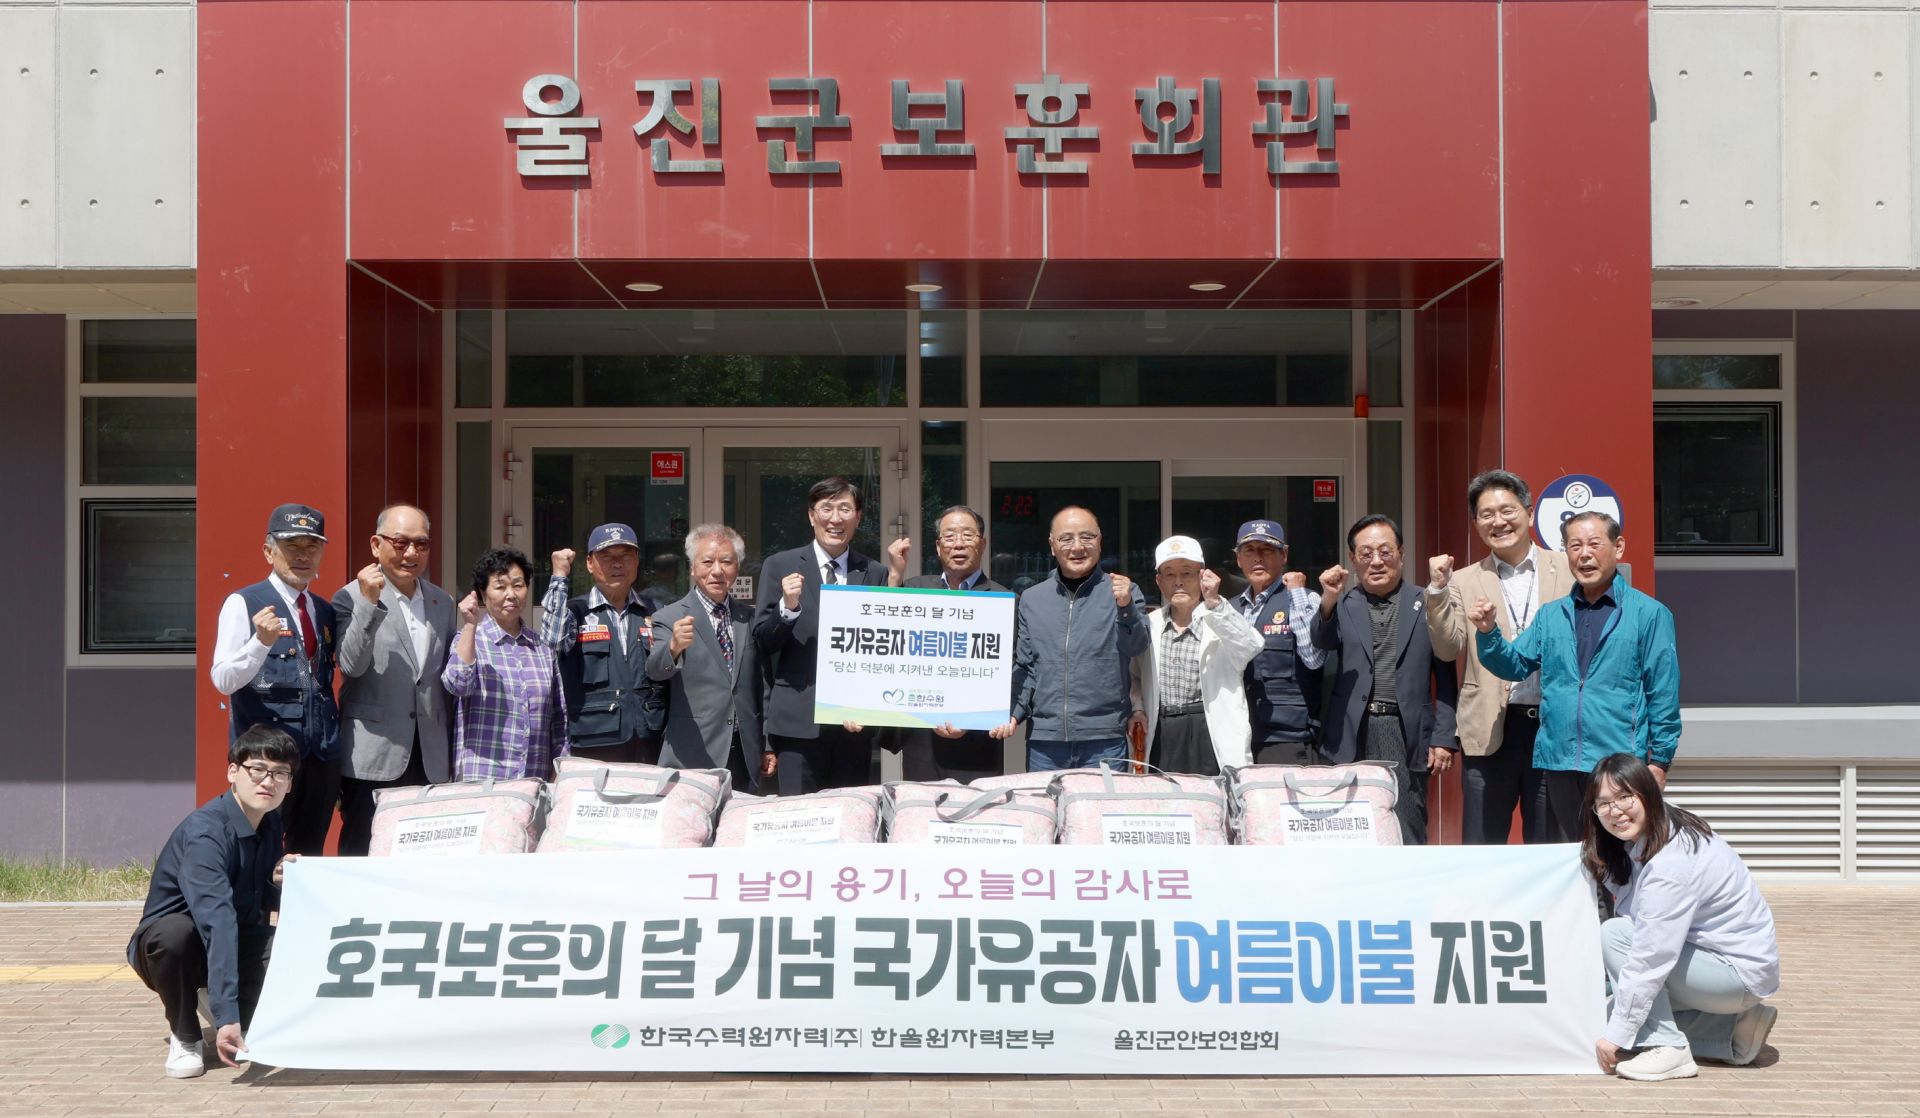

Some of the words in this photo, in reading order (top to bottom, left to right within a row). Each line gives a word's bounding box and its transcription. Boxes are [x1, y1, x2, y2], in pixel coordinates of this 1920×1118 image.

[504, 74, 1349, 178] 울진군보훈회관
[656, 460, 678, 469] 에스원
[861, 603, 927, 618] 호국보훈의
[932, 607, 944, 619] 달
[949, 608, 974, 620] 기념
[830, 626, 905, 656] 국가유공자
[908, 630, 968, 659] 여름이불
[971, 632, 1000, 660] 지원
[899, 664, 933, 677] 지켜낸
[1288, 818, 1324, 832] 국가유공자
[1325, 817, 1354, 831] 여름이불
[1354, 816, 1370, 830] 지원
[398, 828, 433, 845] 국가유공자
[462, 825, 478, 838] 지원
[1109, 831, 1146, 845] 국가유공자
[1146, 831, 1175, 845] 여름이불
[1175, 831, 1191, 845] 지원
[683, 873, 718, 901] 그
[739, 869, 813, 902] 날의
[831, 866, 920, 903] 용기,
[938, 867, 1056, 901] 오늘의
[1075, 868, 1193, 901] 감사로
[316, 917, 626, 999] 호국보훈의
[640, 917, 702, 999] 달
[715, 916, 836, 1000] 기념
[853, 917, 1161, 1005] 국가유공자
[1174, 919, 1416, 1005] 여름이불
[1430, 920, 1548, 1004] 지원
[871, 1026, 1055, 1050] 한울원자력본부
[1114, 1029, 1279, 1051] 울진군안보연합회
